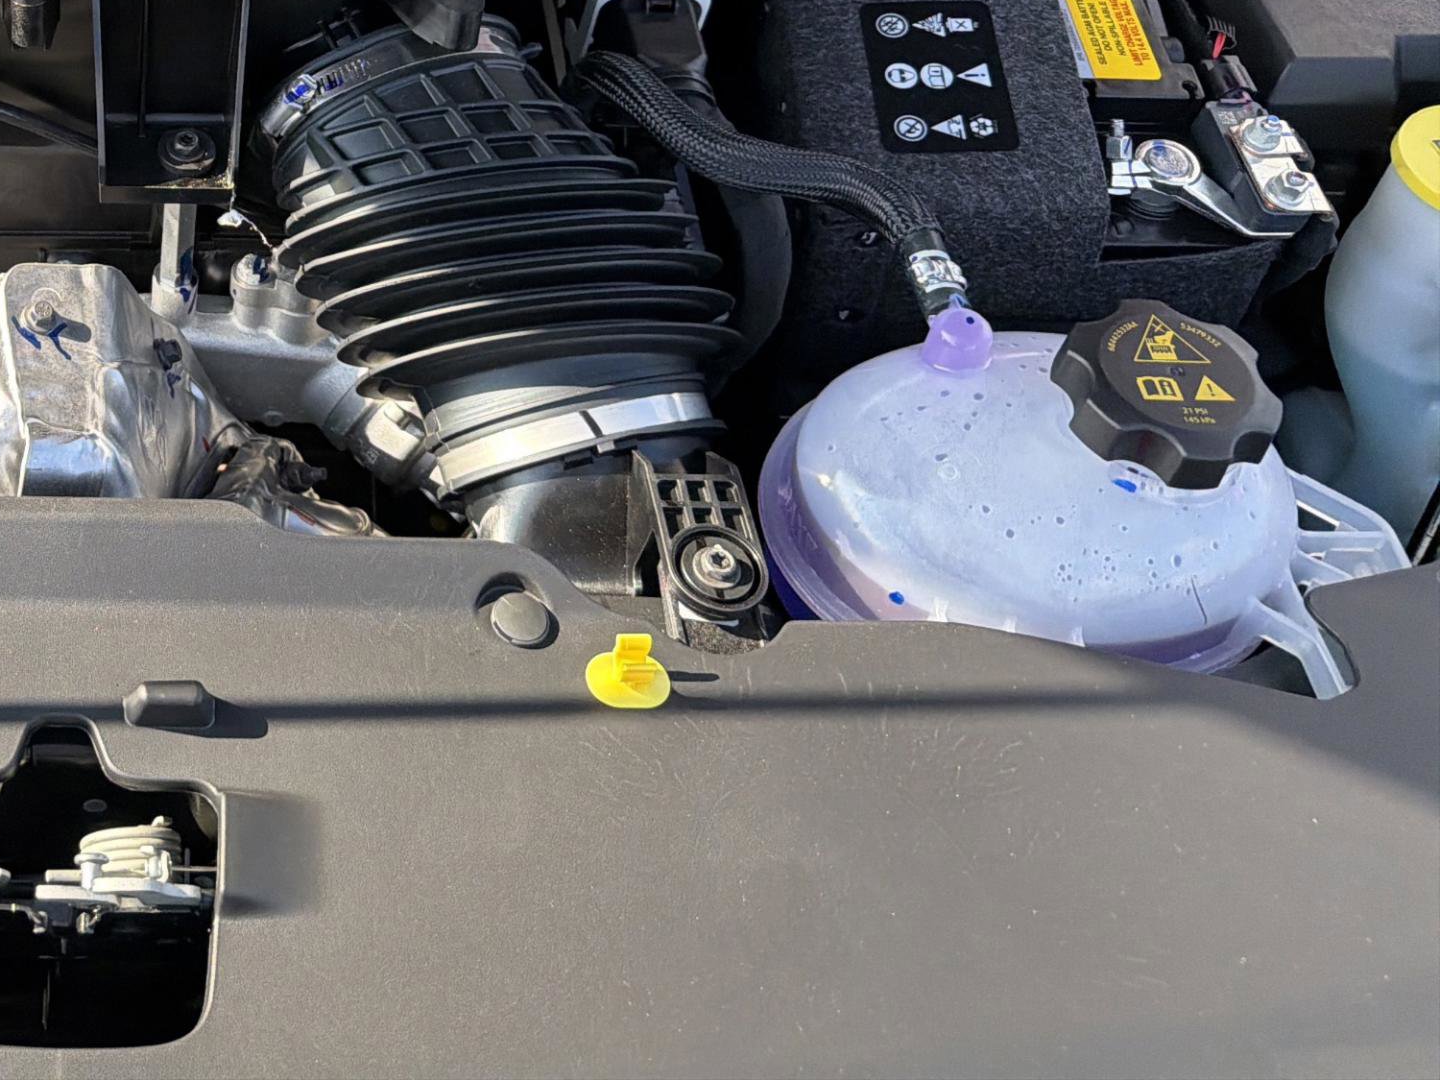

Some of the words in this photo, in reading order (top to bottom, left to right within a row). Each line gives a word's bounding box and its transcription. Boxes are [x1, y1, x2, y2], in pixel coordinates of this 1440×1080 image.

[1083, 20, 1096, 36] AGM
[1096, 25, 1108, 39] NOT
[1098, 1, 1126, 56] NON-SPILLABLE
[1118, 23, 1134, 47] CHARGE
[1127, 16, 1140, 37] VOLTS
[1089, 37, 1108, 65] SEALED
[1102, 40, 1112, 51] DO
[1130, 49, 1142, 66] LIMIT
[1140, 52, 1150, 61] TO
